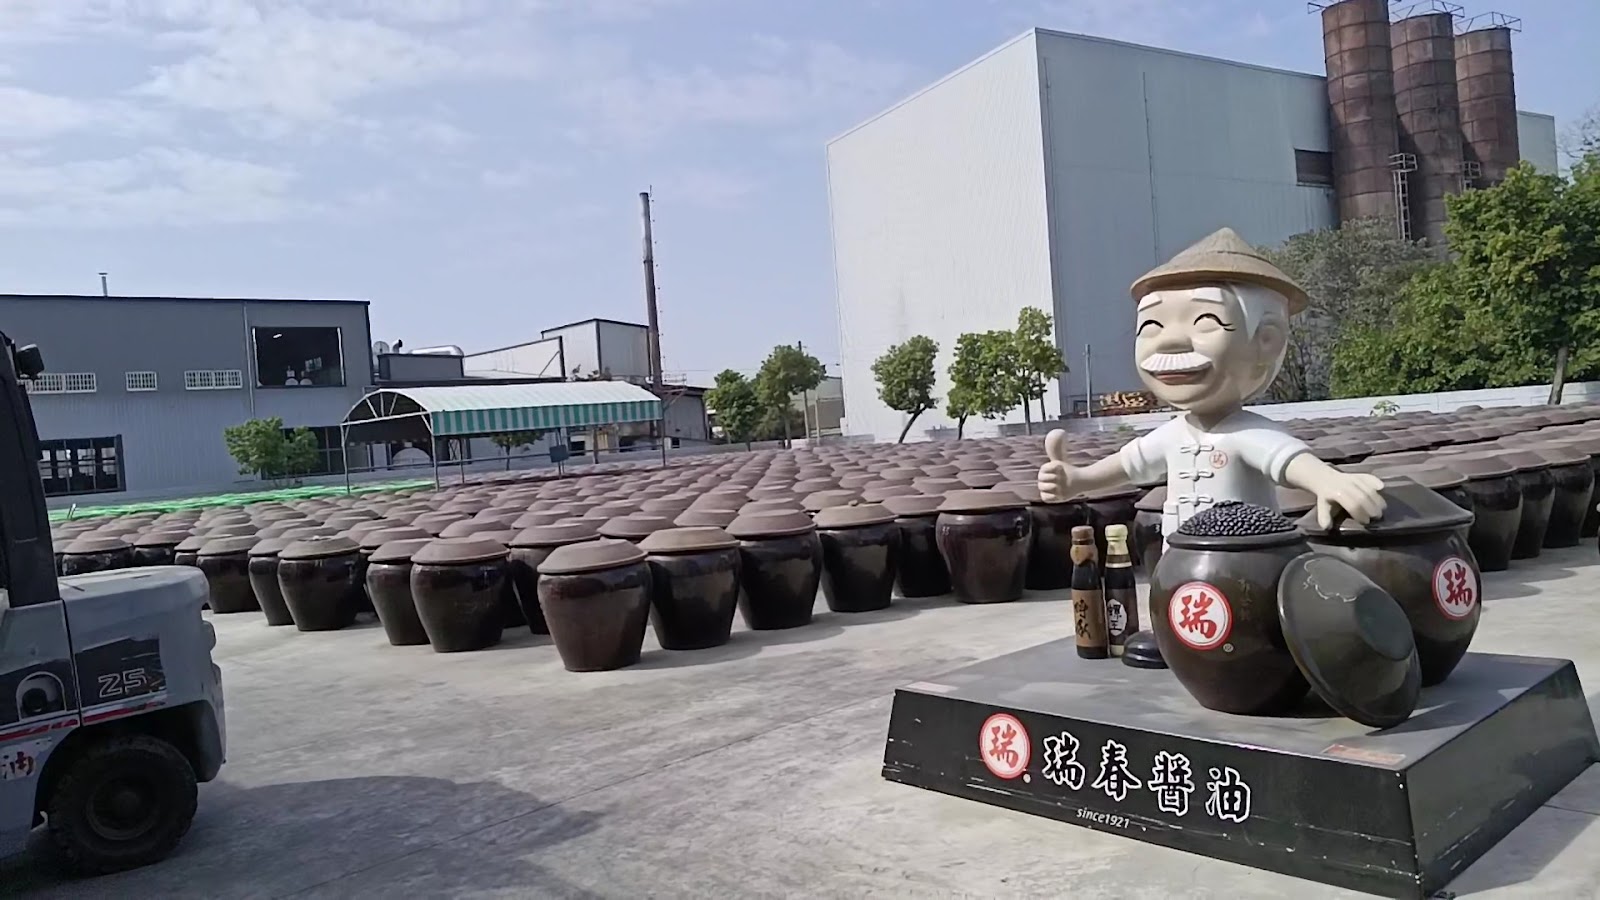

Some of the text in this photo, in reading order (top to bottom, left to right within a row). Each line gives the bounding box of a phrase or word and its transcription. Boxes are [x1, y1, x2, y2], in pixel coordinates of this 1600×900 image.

[1442, 562, 1473, 608] 瑞
[1179, 591, 1218, 639] 瑞
[989, 723, 1020, 768] 瑞
[1042, 731, 1251, 823] 瑞春醬油
[1076, 806, 1130, 829] since1921
